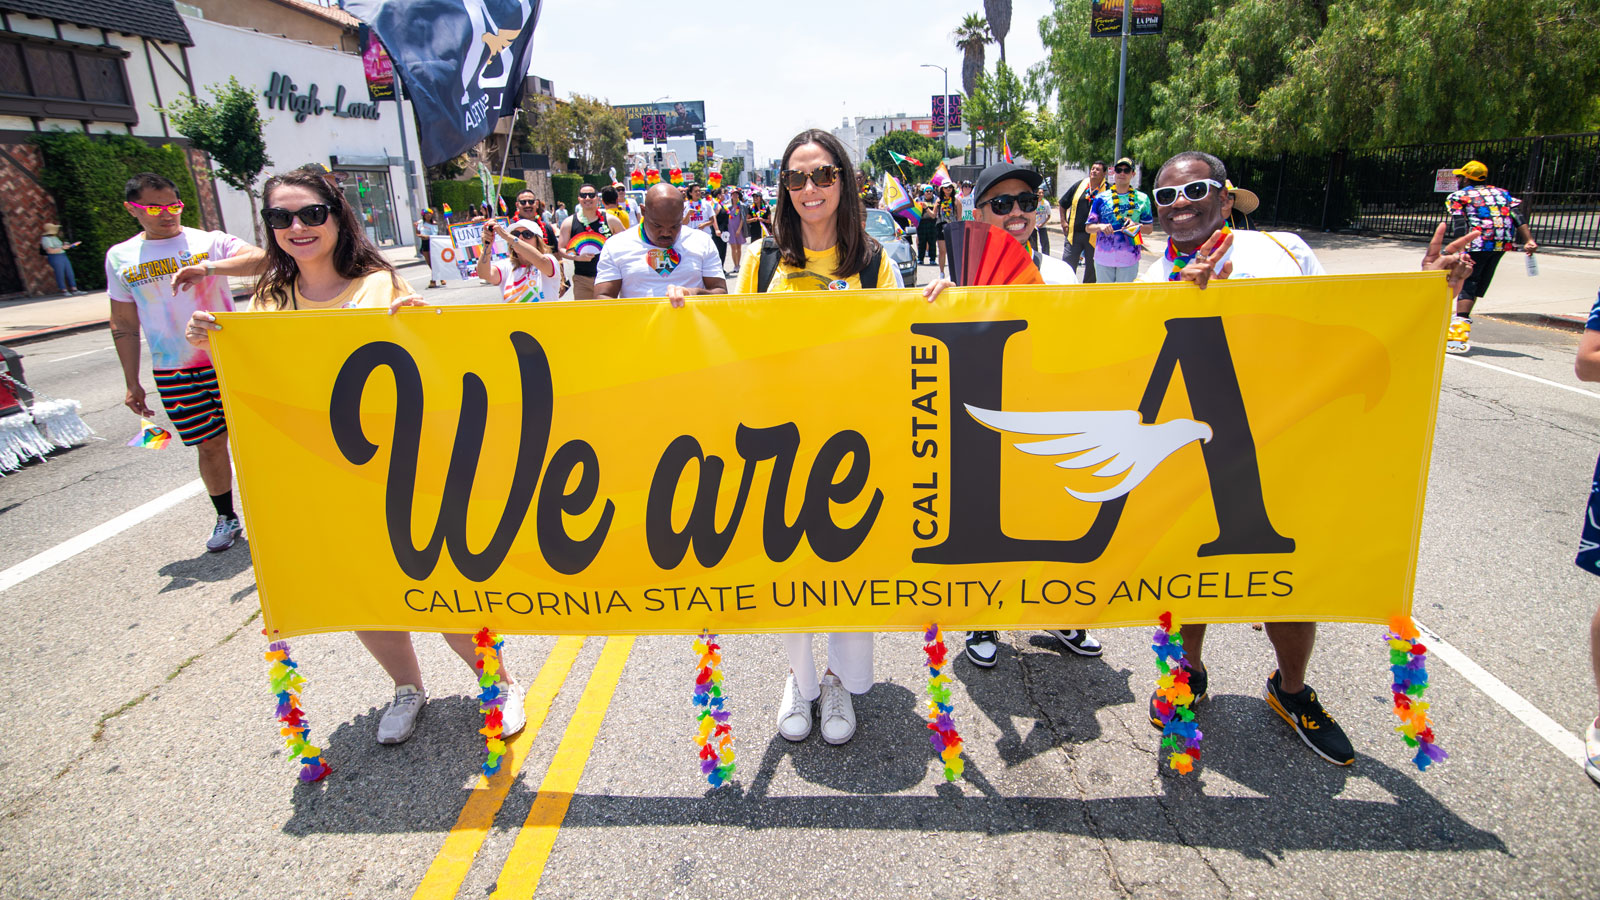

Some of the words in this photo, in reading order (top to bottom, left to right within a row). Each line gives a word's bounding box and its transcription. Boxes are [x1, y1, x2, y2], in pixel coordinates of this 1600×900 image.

[263, 71, 380, 123] High-Land
[122, 257, 180, 283] CALIFORNIA
[911, 345, 938, 458] STATE
[330, 331, 616, 583] We
[646, 422, 883, 570] are
[911, 316, 1296, 565] LA
[912, 472, 938, 540] CAL
[404, 588, 632, 616] CALIFORNIA
[644, 584, 757, 612] STATE
[772, 578, 1004, 609] UNIVERSITY,
[1020, 579, 1097, 605] LOS
[1107, 571, 1294, 606] ANGELES
